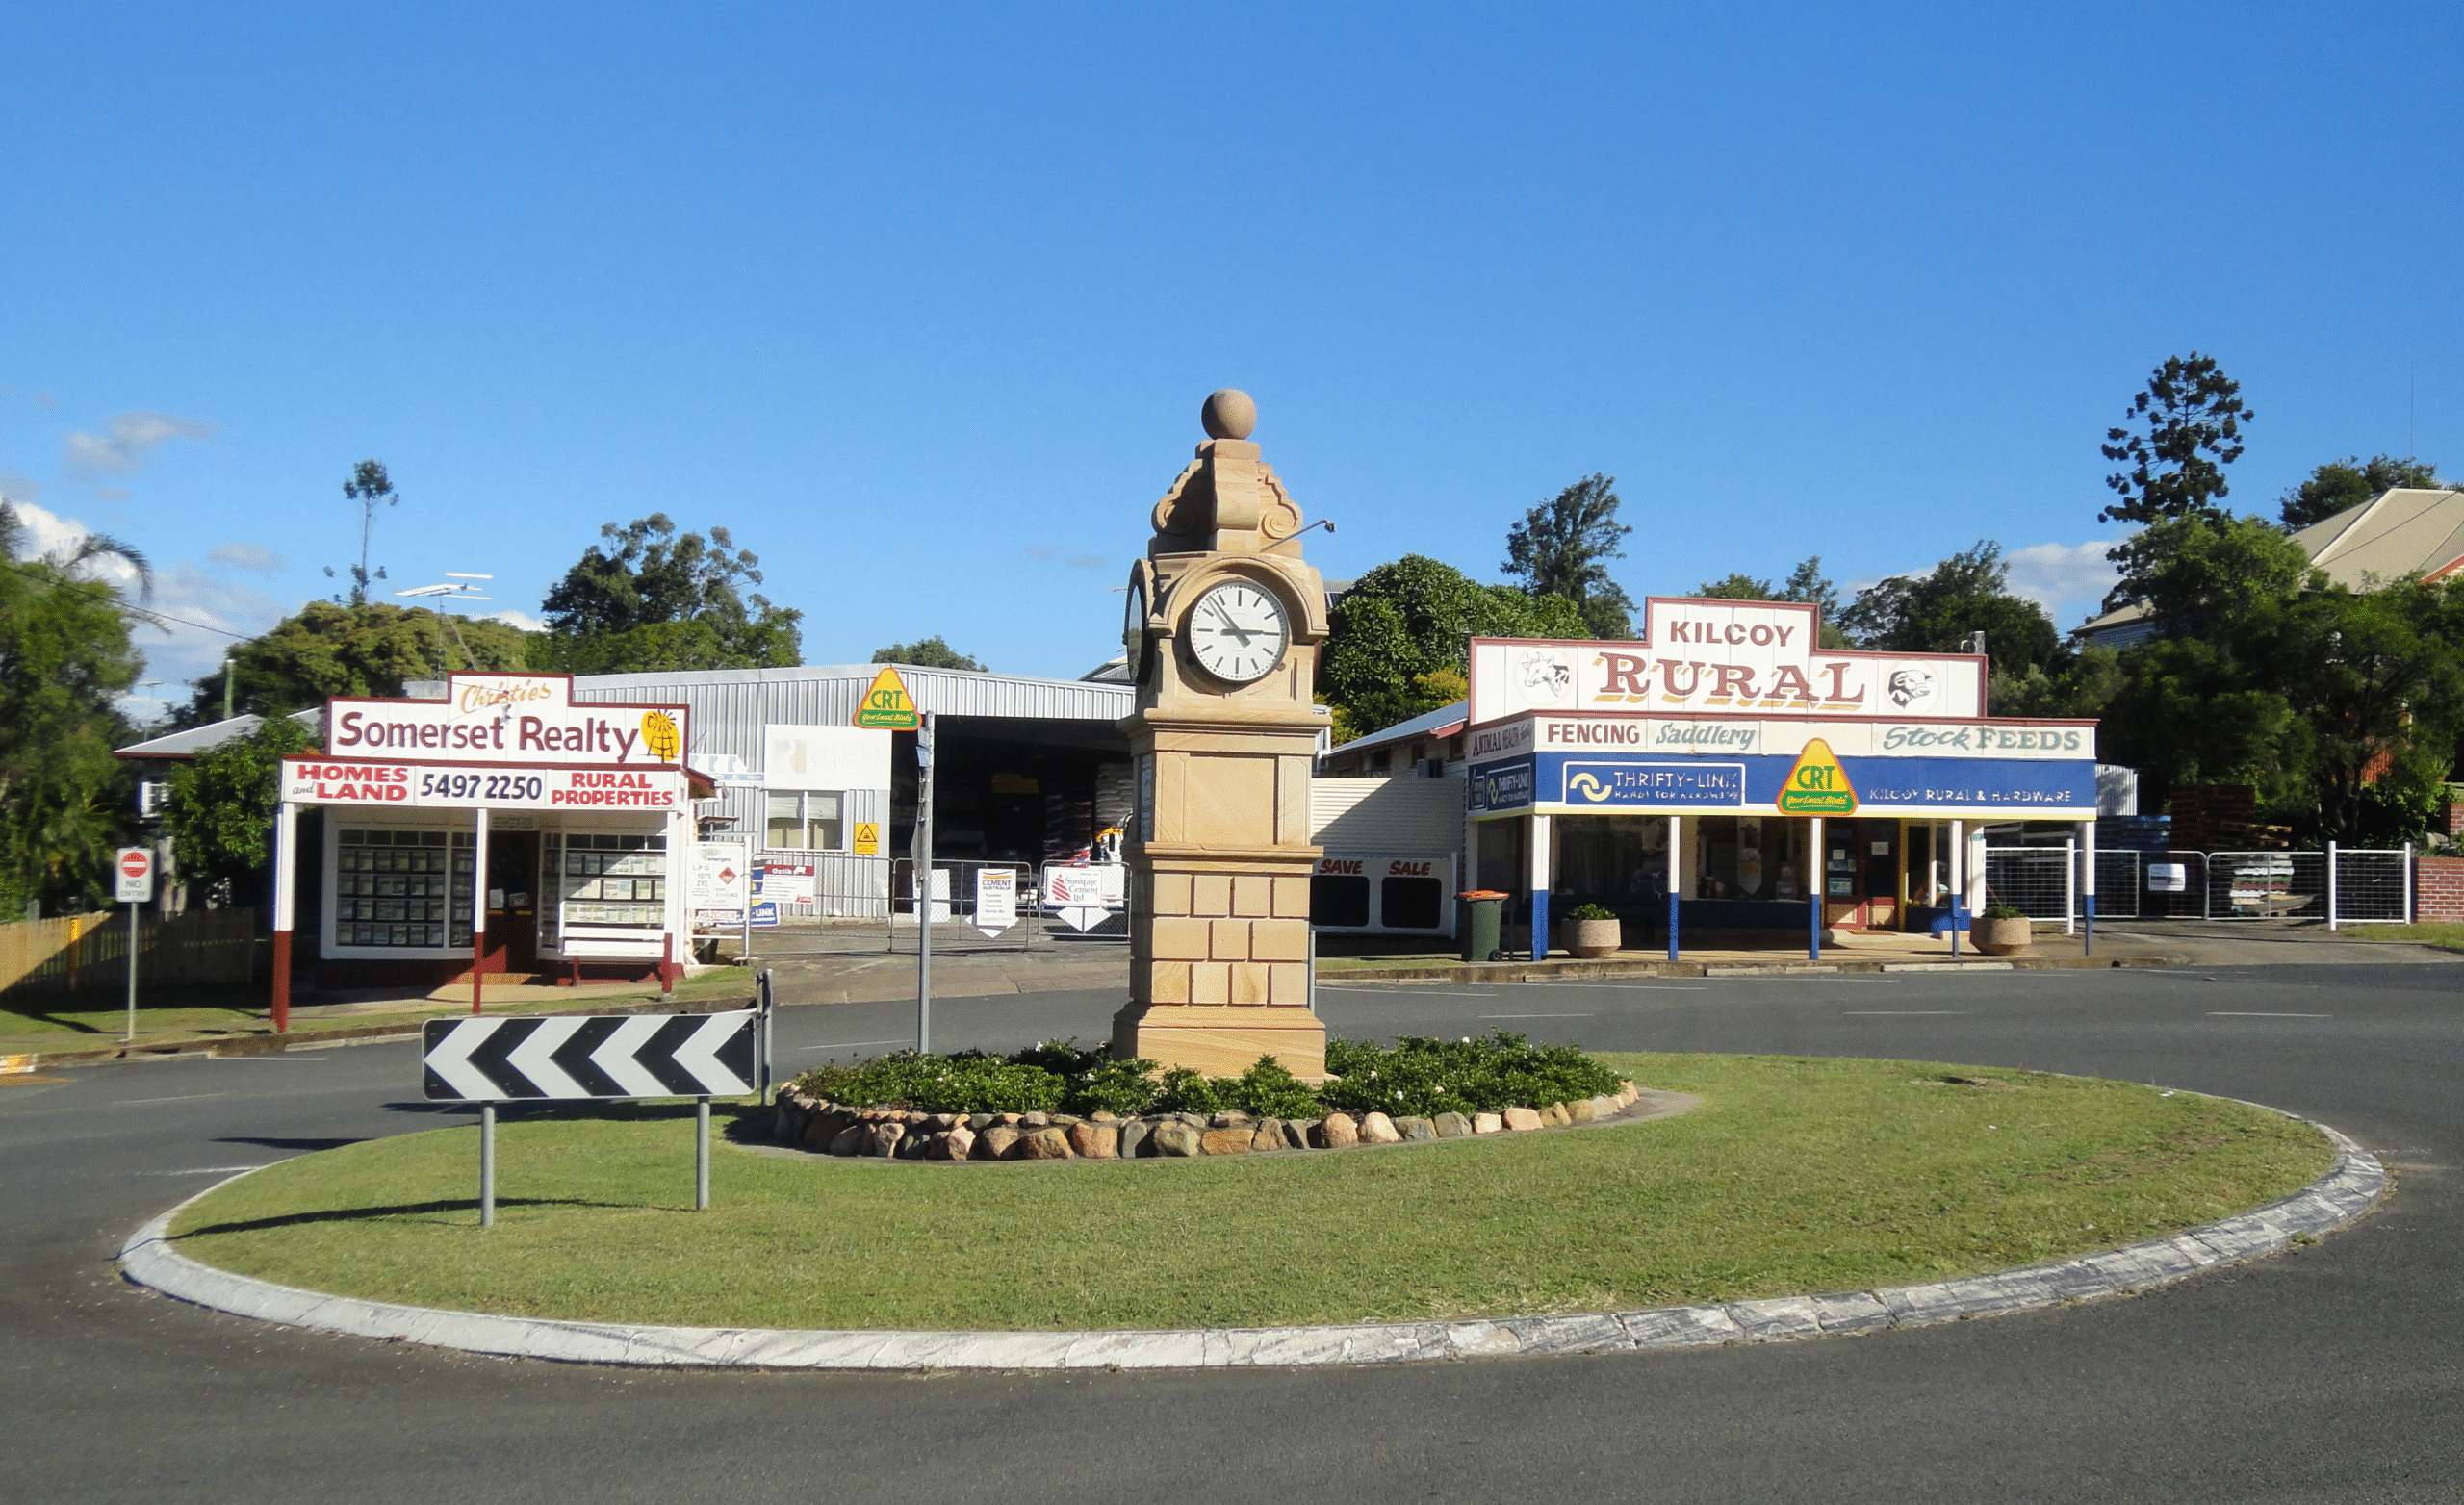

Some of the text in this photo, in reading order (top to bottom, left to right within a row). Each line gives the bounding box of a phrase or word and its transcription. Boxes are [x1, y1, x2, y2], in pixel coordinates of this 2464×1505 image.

[1670, 621, 1795, 647] KILCOY
[1594, 651, 1865, 709] RURAL
[459, 679, 552, 714] Christies
[870, 690, 903, 710] CRT
[337, 711, 639, 764] Somerset Realty
[1473, 731, 1502, 756] ANIMAL
[1548, 724, 1640, 744] FENCING
[1656, 723, 1757, 751] Saddlery
[1883, 726, 2081, 752] Stock FEEDS
[296, 764, 409, 782] HOMES
[570, 772, 653, 789] RURAL
[1613, 771, 1738, 788] THRIFTY-LINK
[1796, 765, 1836, 790] CRT
[292, 780, 408, 802] and LAND
[420, 773, 543, 800] 5497 2250
[552, 788, 674, 806] PROPERTIES
[1869, 788, 2072, 803] KILCOY RURAL & HARDWARE
[1319, 859, 1363, 875] SAVE
[1389, 860, 1431, 876] SALE
[1065, 877, 1097, 887] Sunstate
[1068, 885, 1099, 896] Cement
